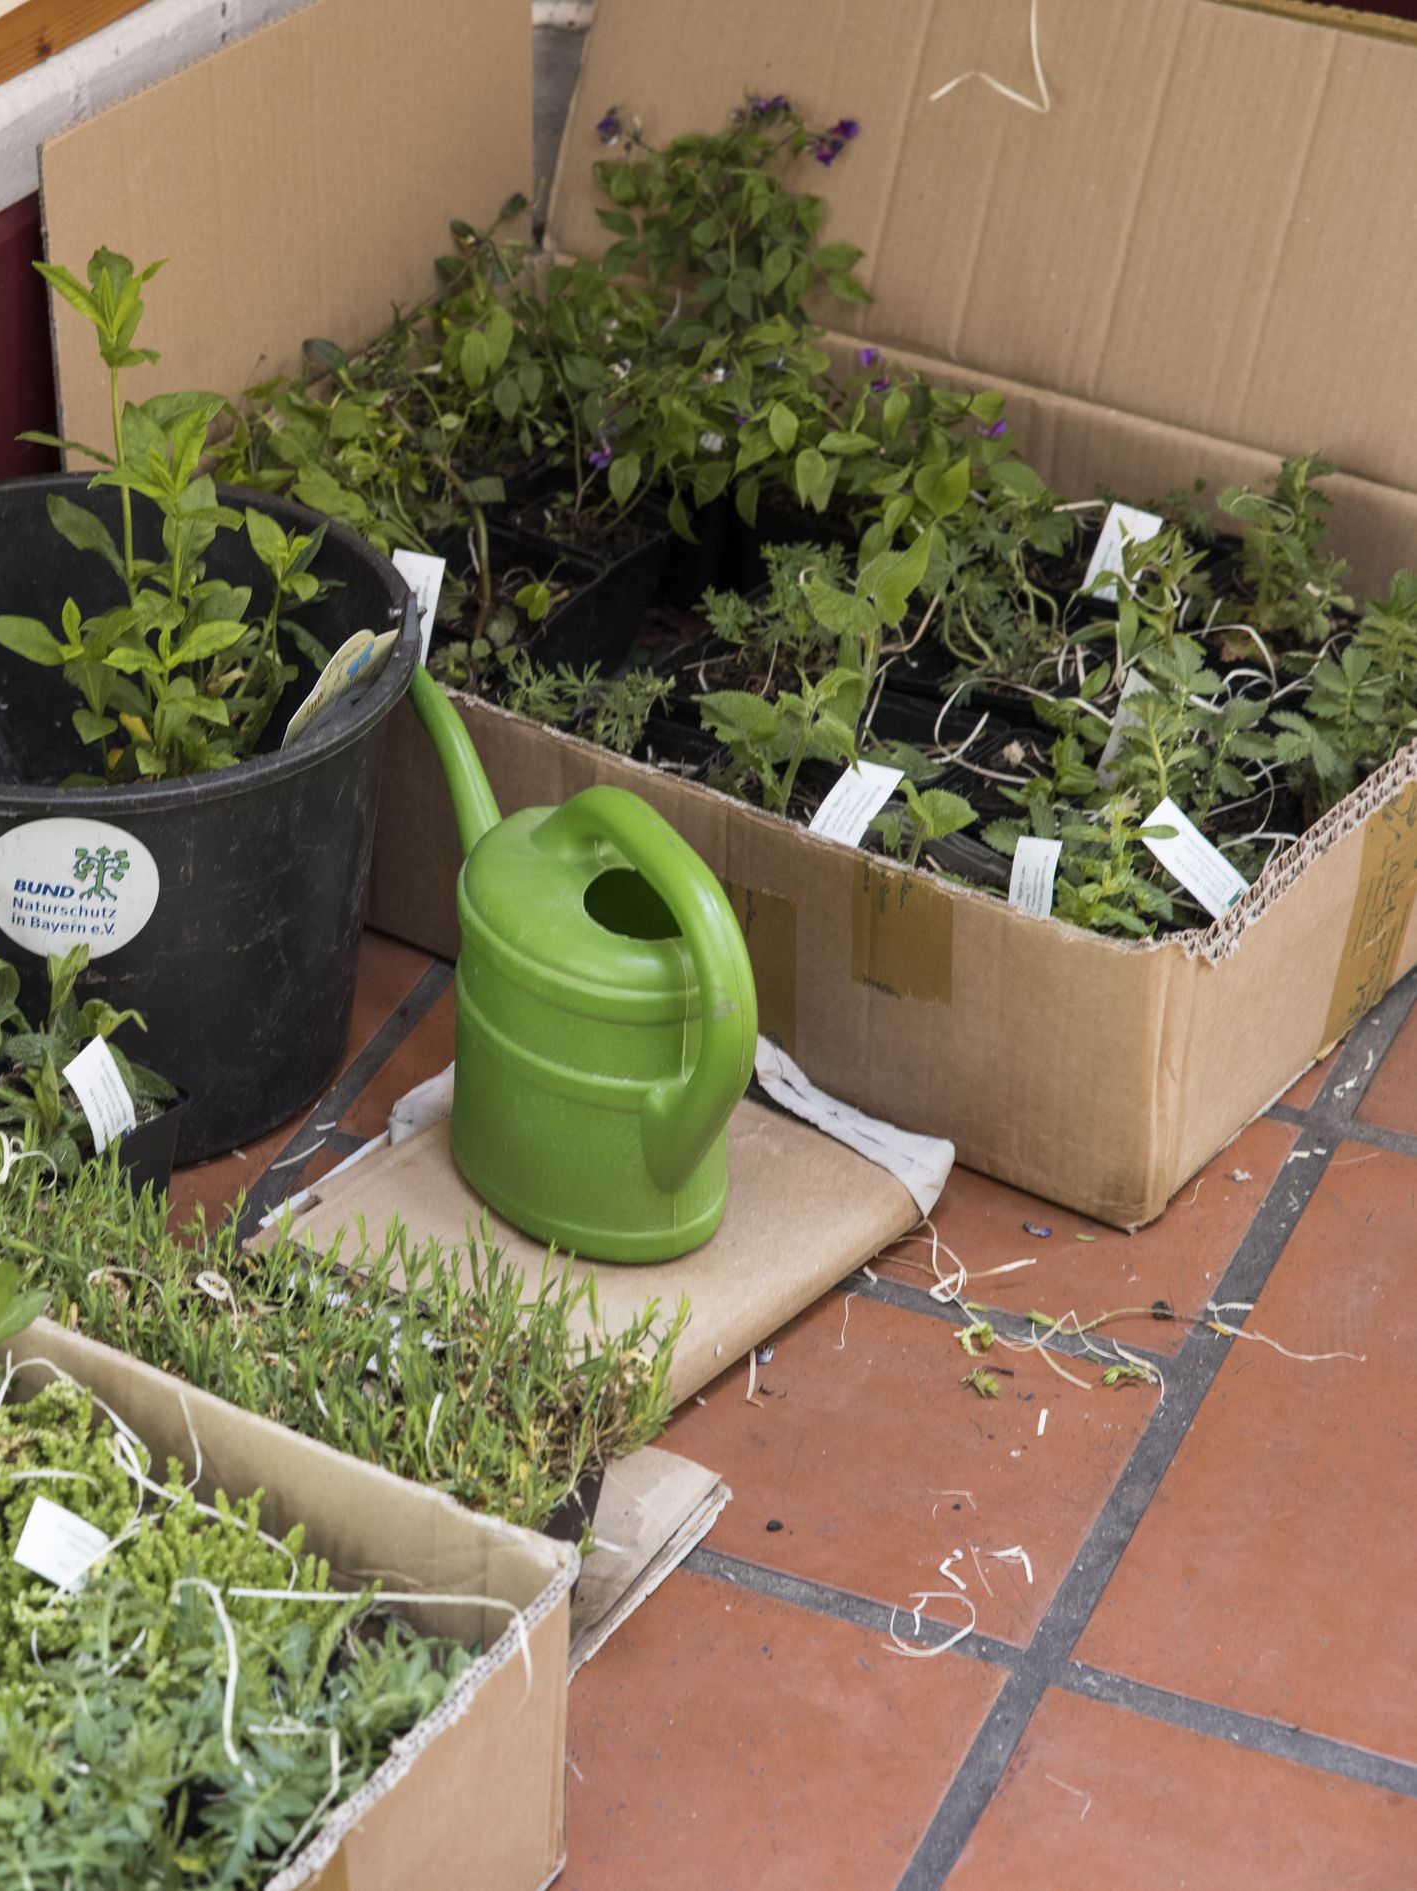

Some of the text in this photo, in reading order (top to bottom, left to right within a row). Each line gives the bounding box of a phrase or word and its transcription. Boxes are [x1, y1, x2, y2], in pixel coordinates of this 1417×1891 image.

[13, 878, 75, 900] BUND
[12, 896, 118, 920] Naturschutz
[11, 911, 116, 936] in Bayern e.V.
